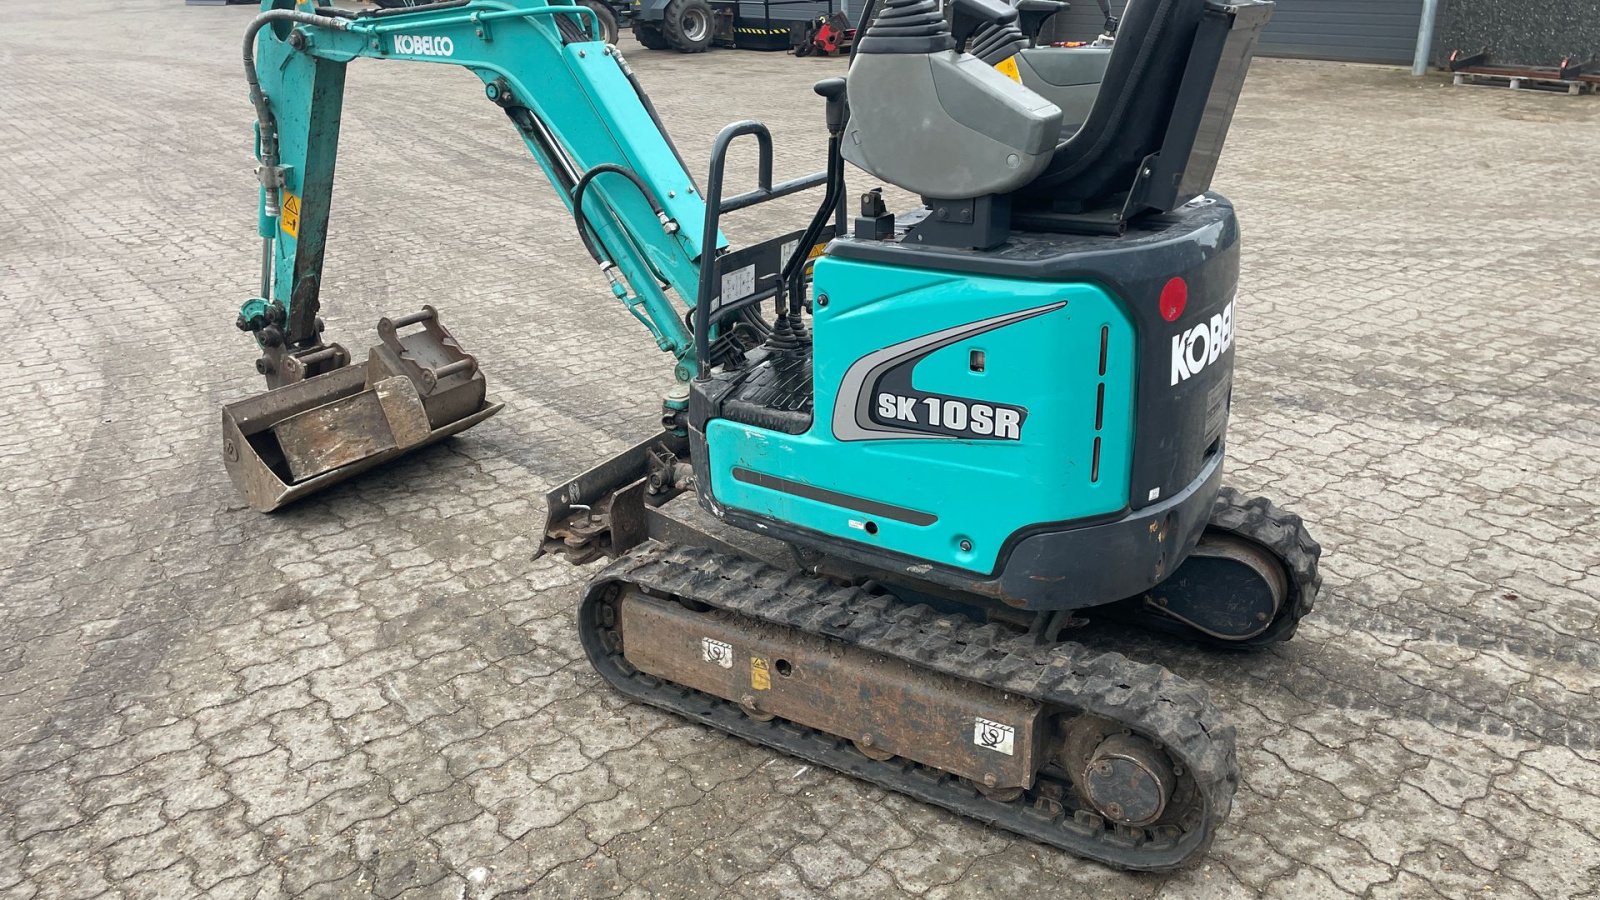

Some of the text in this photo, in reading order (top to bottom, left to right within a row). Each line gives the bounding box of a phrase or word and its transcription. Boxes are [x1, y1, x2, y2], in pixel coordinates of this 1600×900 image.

[393, 34, 454, 56] KOBELCO
[878, 392, 1020, 440] SK 10SR
